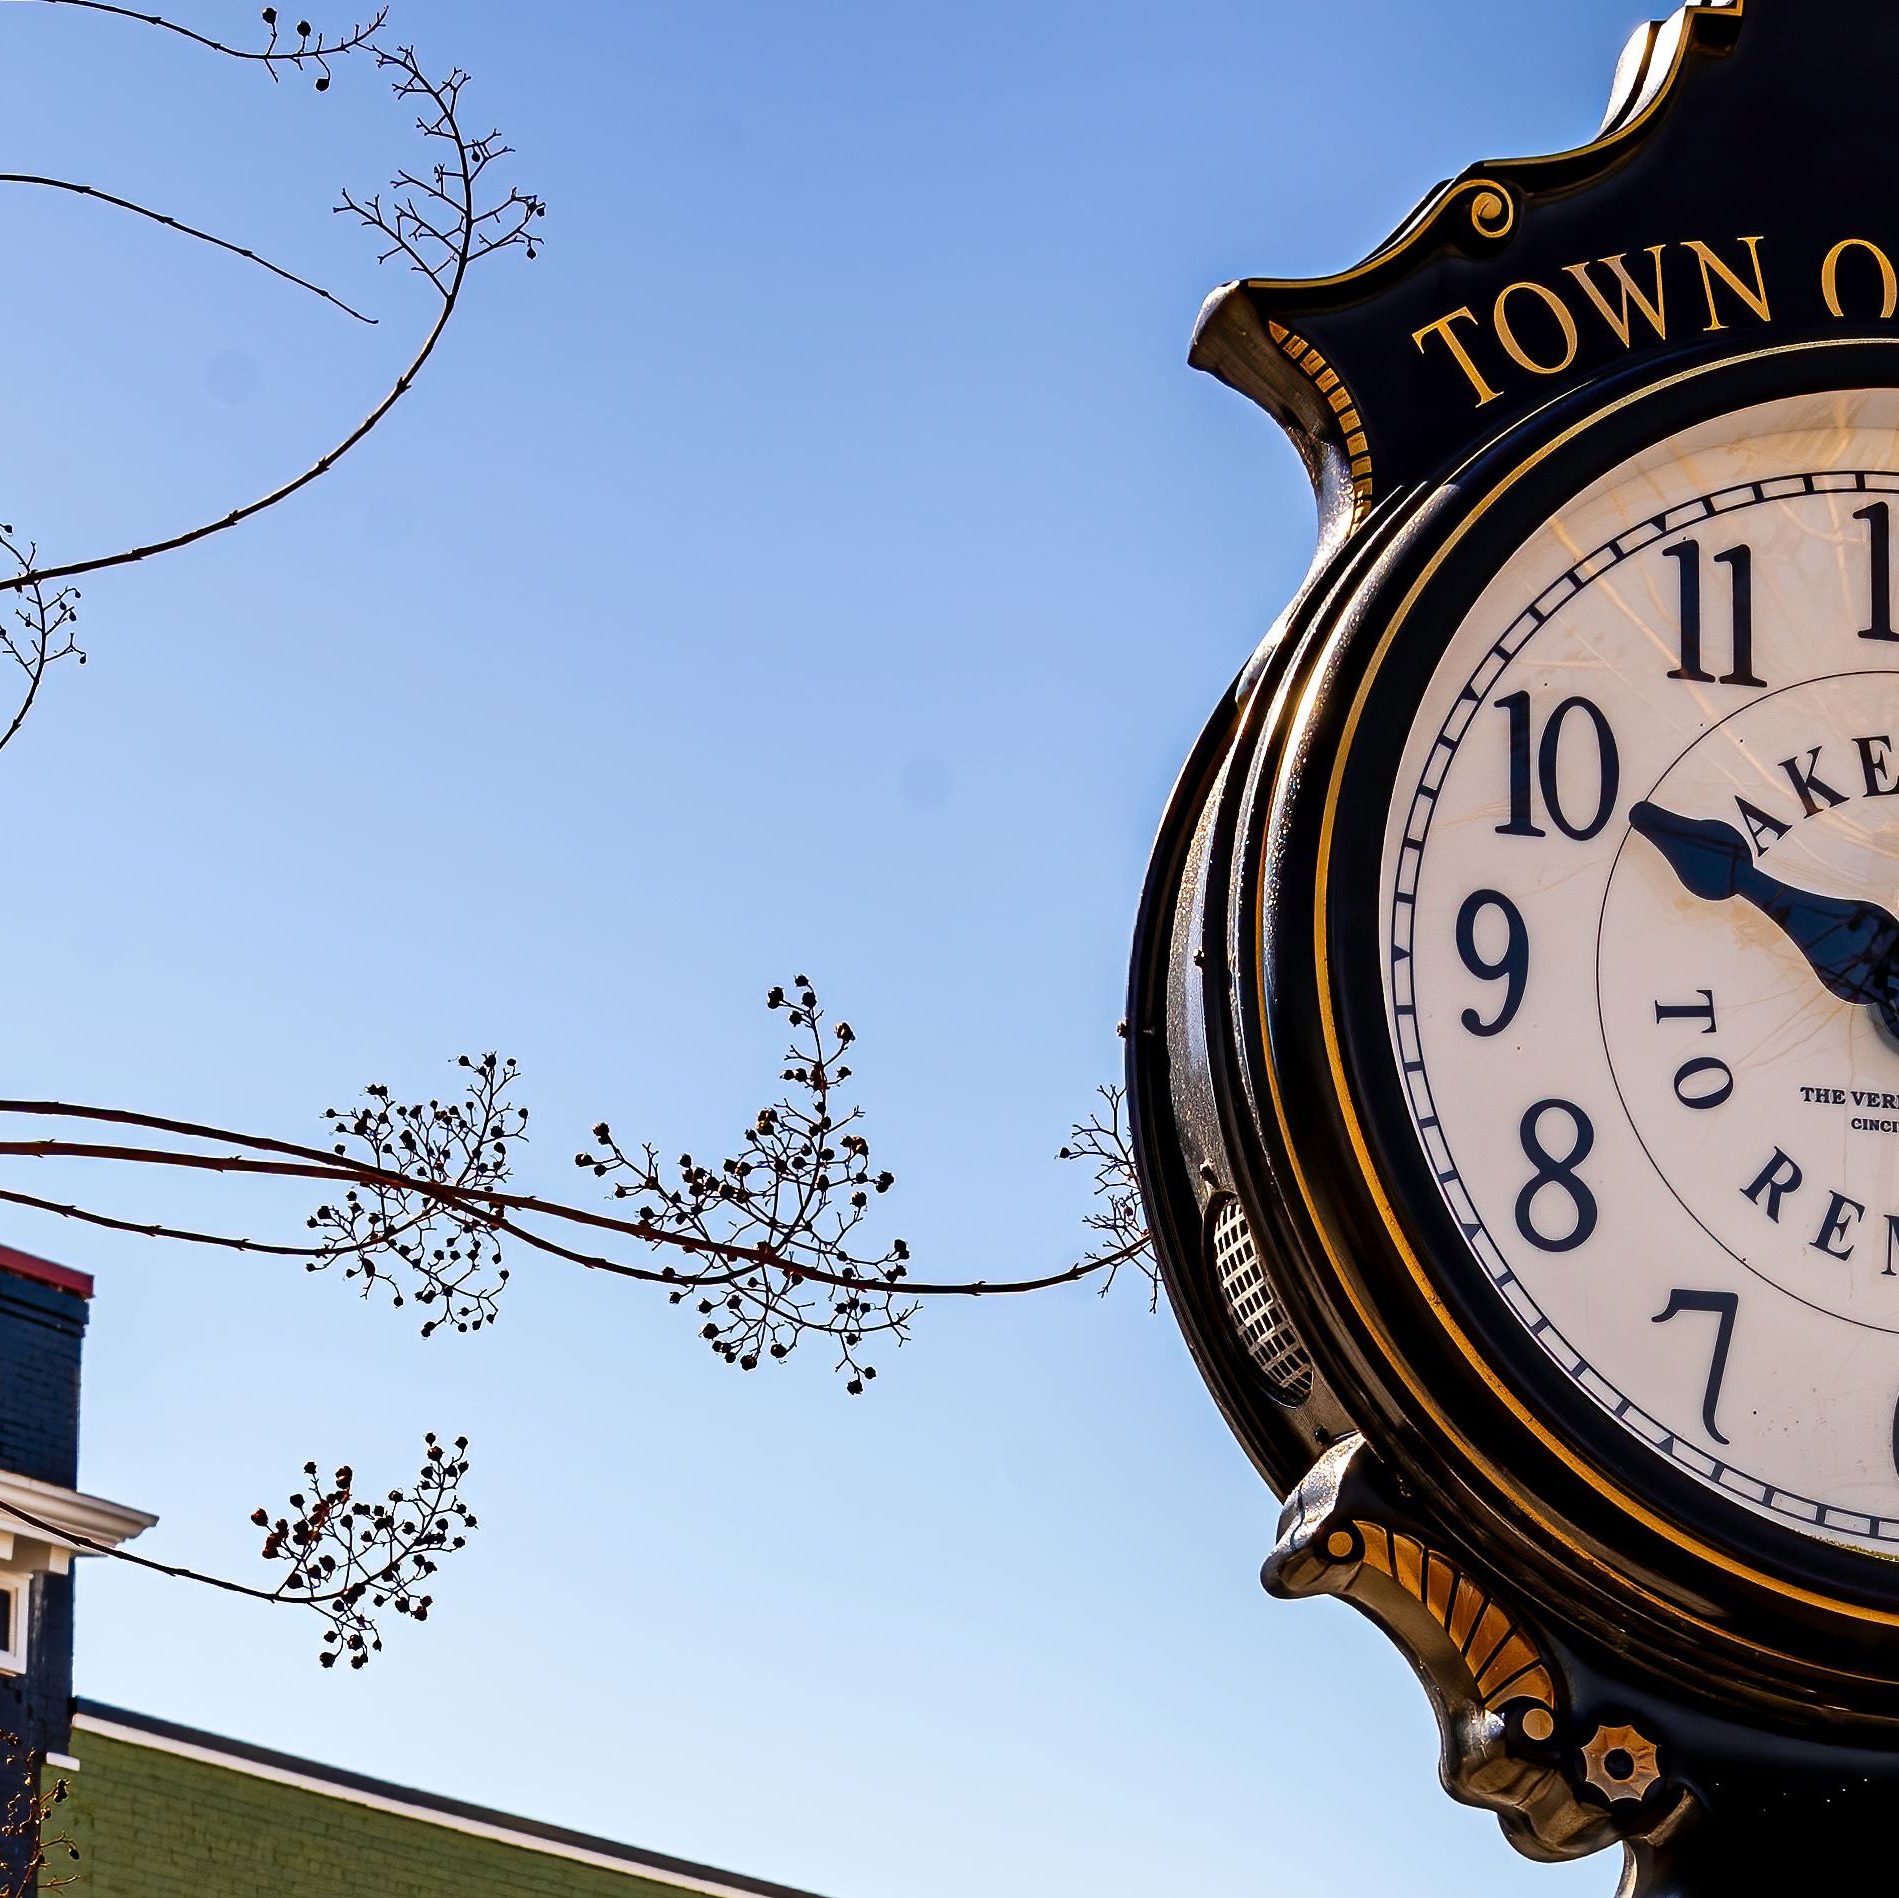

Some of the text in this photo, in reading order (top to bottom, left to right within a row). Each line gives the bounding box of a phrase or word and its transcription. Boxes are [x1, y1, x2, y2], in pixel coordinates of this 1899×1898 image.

[1411, 235, 1771, 409] TOWN
[1662, 540, 1767, 689] 11
[1496, 691, 1619, 842] 10
[1455, 888, 1530, 1039] 9
[1653, 989, 1735, 1111] TO
[1800, 1086, 1846, 1105] THE
[1513, 1097, 1600, 1253] 8
[1651, 1288, 1740, 1446] 7
